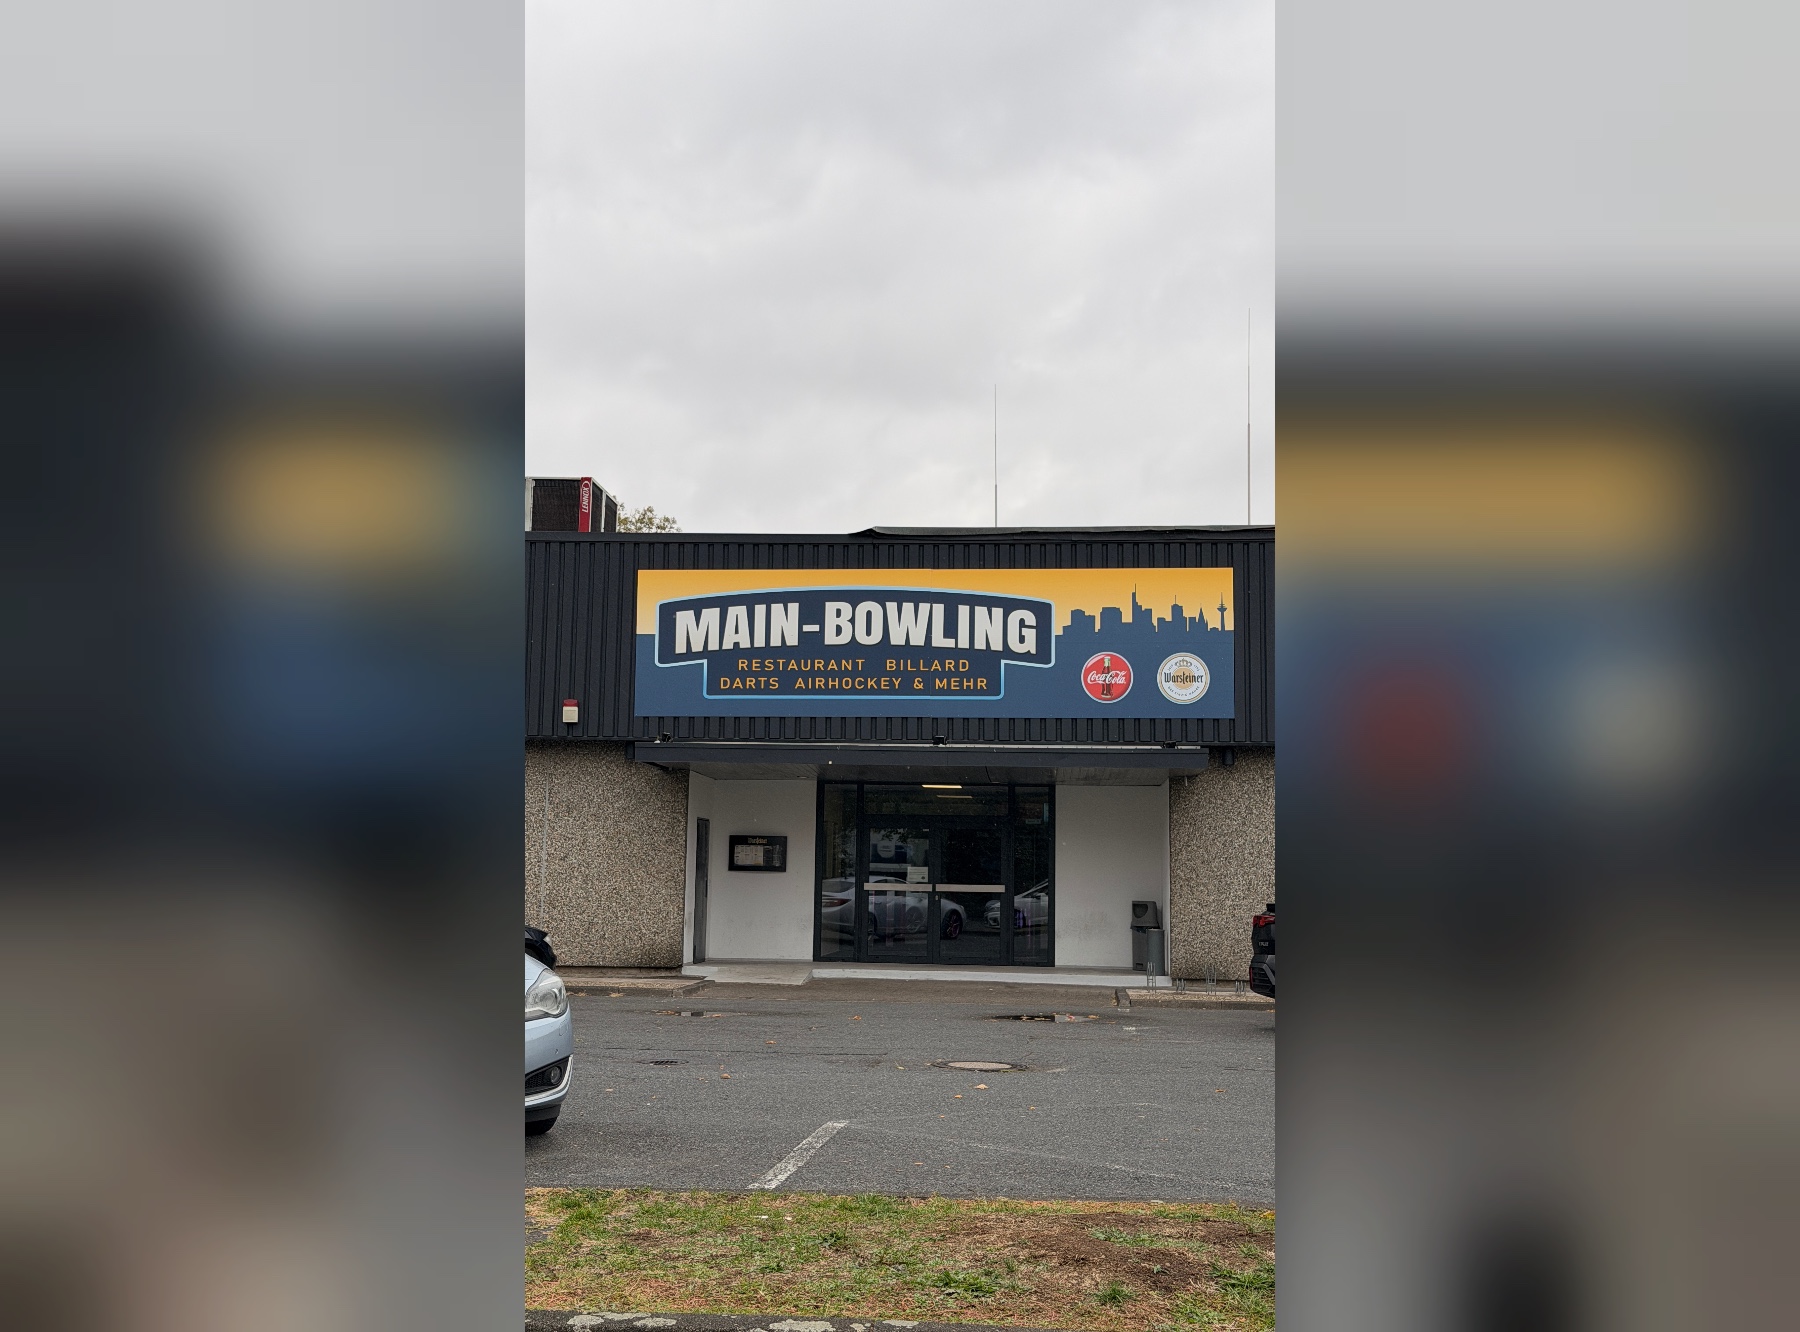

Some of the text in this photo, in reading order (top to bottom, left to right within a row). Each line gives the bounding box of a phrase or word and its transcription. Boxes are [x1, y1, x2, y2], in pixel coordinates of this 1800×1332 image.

[581, 487, 590, 513] LENNOX
[674, 601, 1038, 655] MAIN-BOWLING
[738, 659, 970, 672] RESTAURANT BILLARD
[720, 677, 988, 690] DARTS AIRHOCKEY & MEHR
[1164, 671, 1204, 684] Warsteiner
